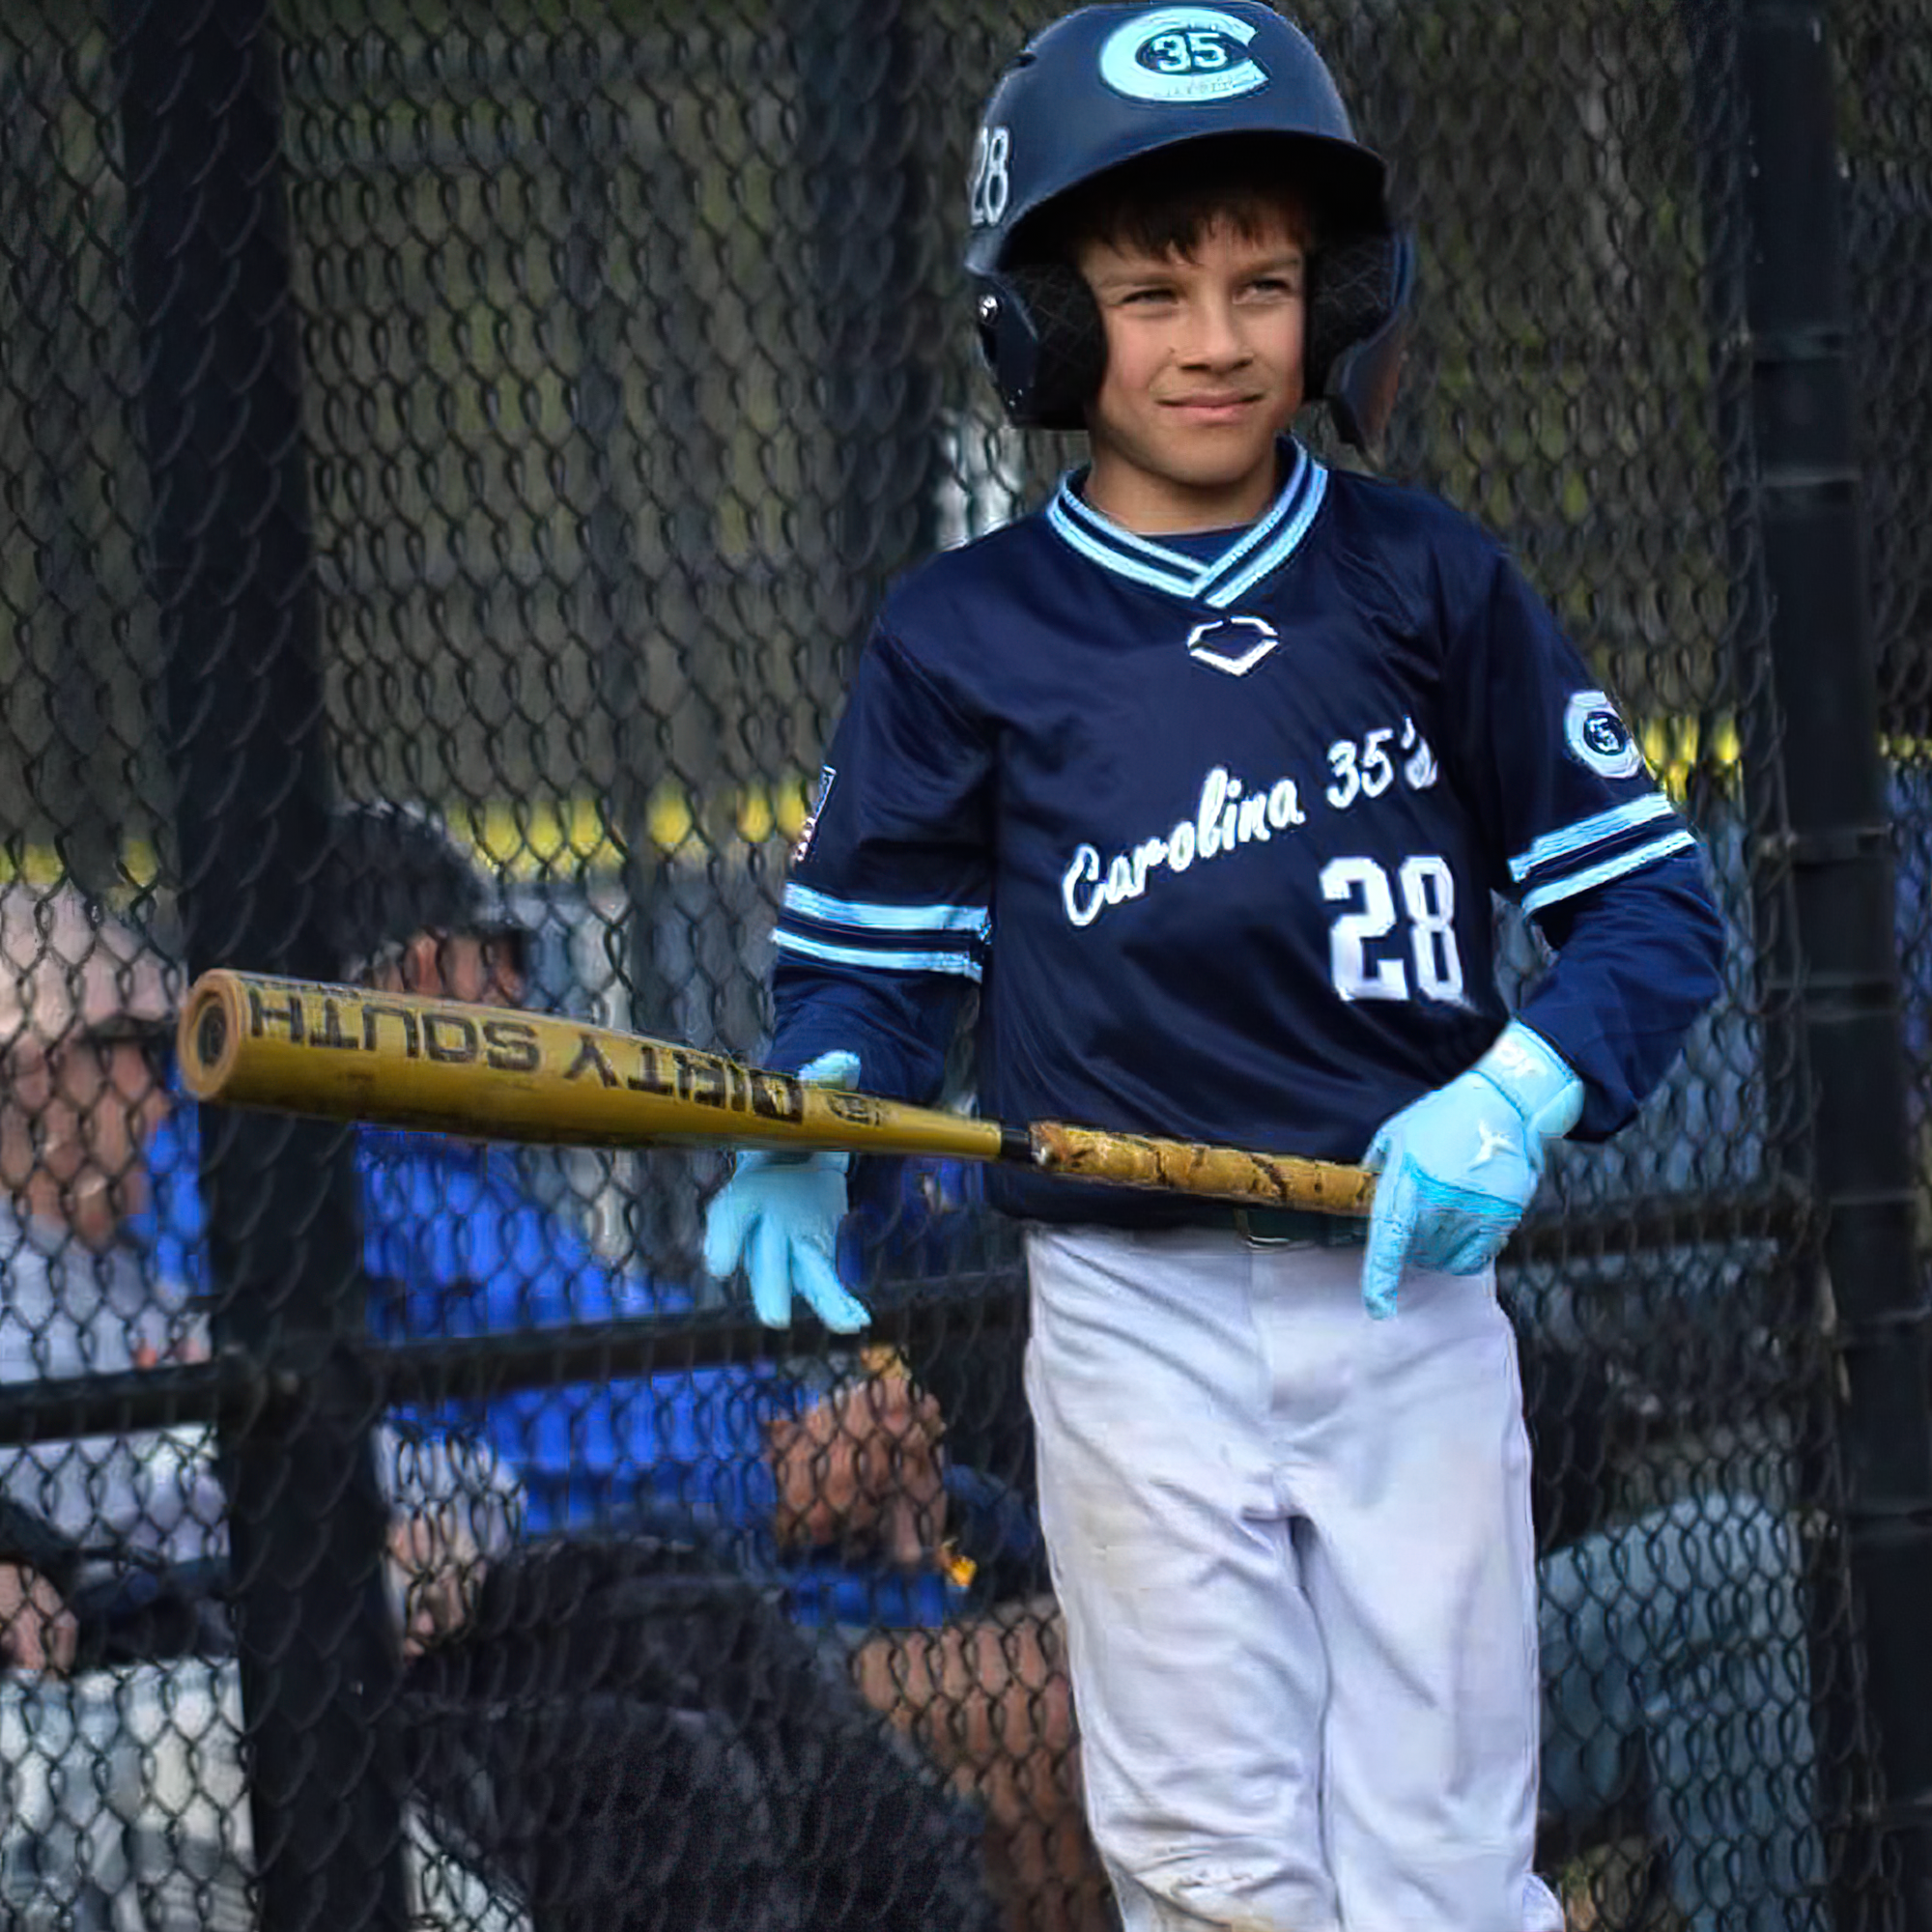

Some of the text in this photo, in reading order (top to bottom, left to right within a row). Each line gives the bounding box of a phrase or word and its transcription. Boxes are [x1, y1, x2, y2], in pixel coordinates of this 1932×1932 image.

[1151, 32, 1229, 72] 35
[1063, 767, 1305, 926] Carolina
[1320, 855, 1463, 1002] 28
[248, 987, 540, 1072] SOUTH
